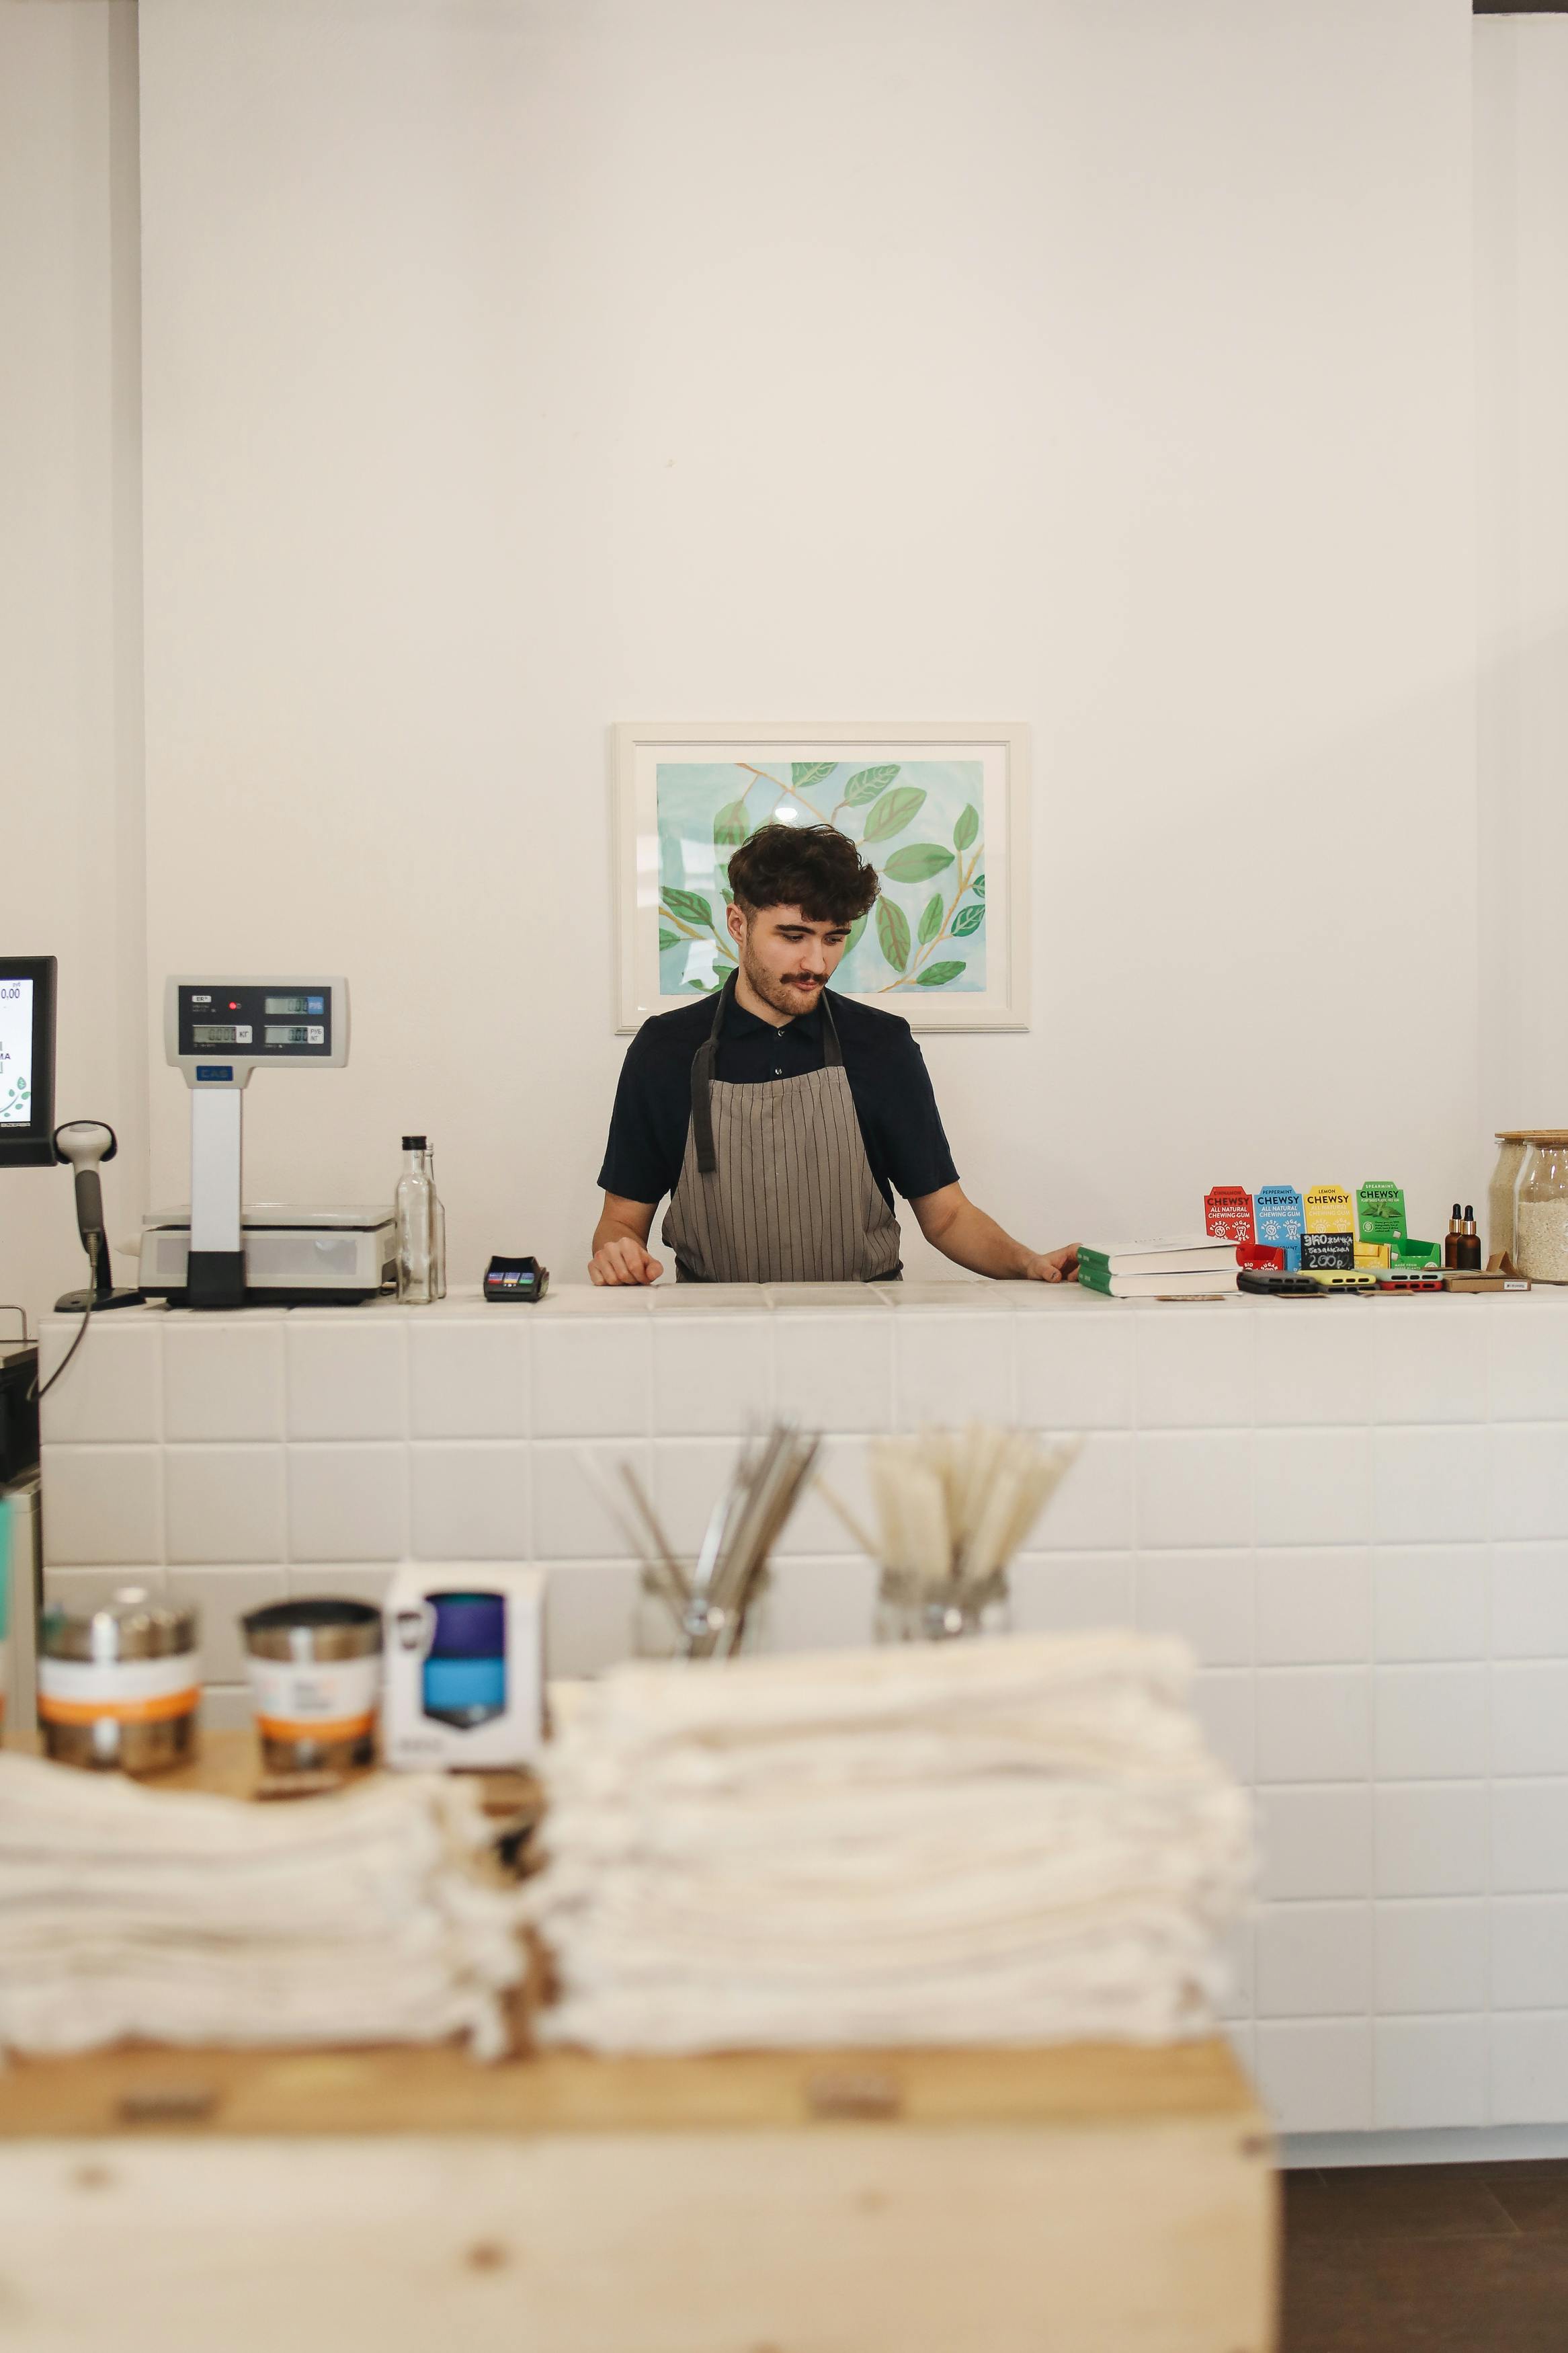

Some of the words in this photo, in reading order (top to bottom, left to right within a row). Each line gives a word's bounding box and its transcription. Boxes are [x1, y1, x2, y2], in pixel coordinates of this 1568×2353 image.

[1207, 1197, 1249, 1205] CHEWSY
[1257, 1196, 1300, 1205] CHEWSY
[1307, 1195, 1349, 1204] CHEWSY
[1209, 1220, 1231, 1231] PLASTIC
[1231, 1220, 1251, 1229] SUGAR
[1261, 1220, 1282, 1231] PLASTIC
[1282, 1219, 1302, 1228] SUGAR
[1303, 1234, 1327, 1246] ЭКО
